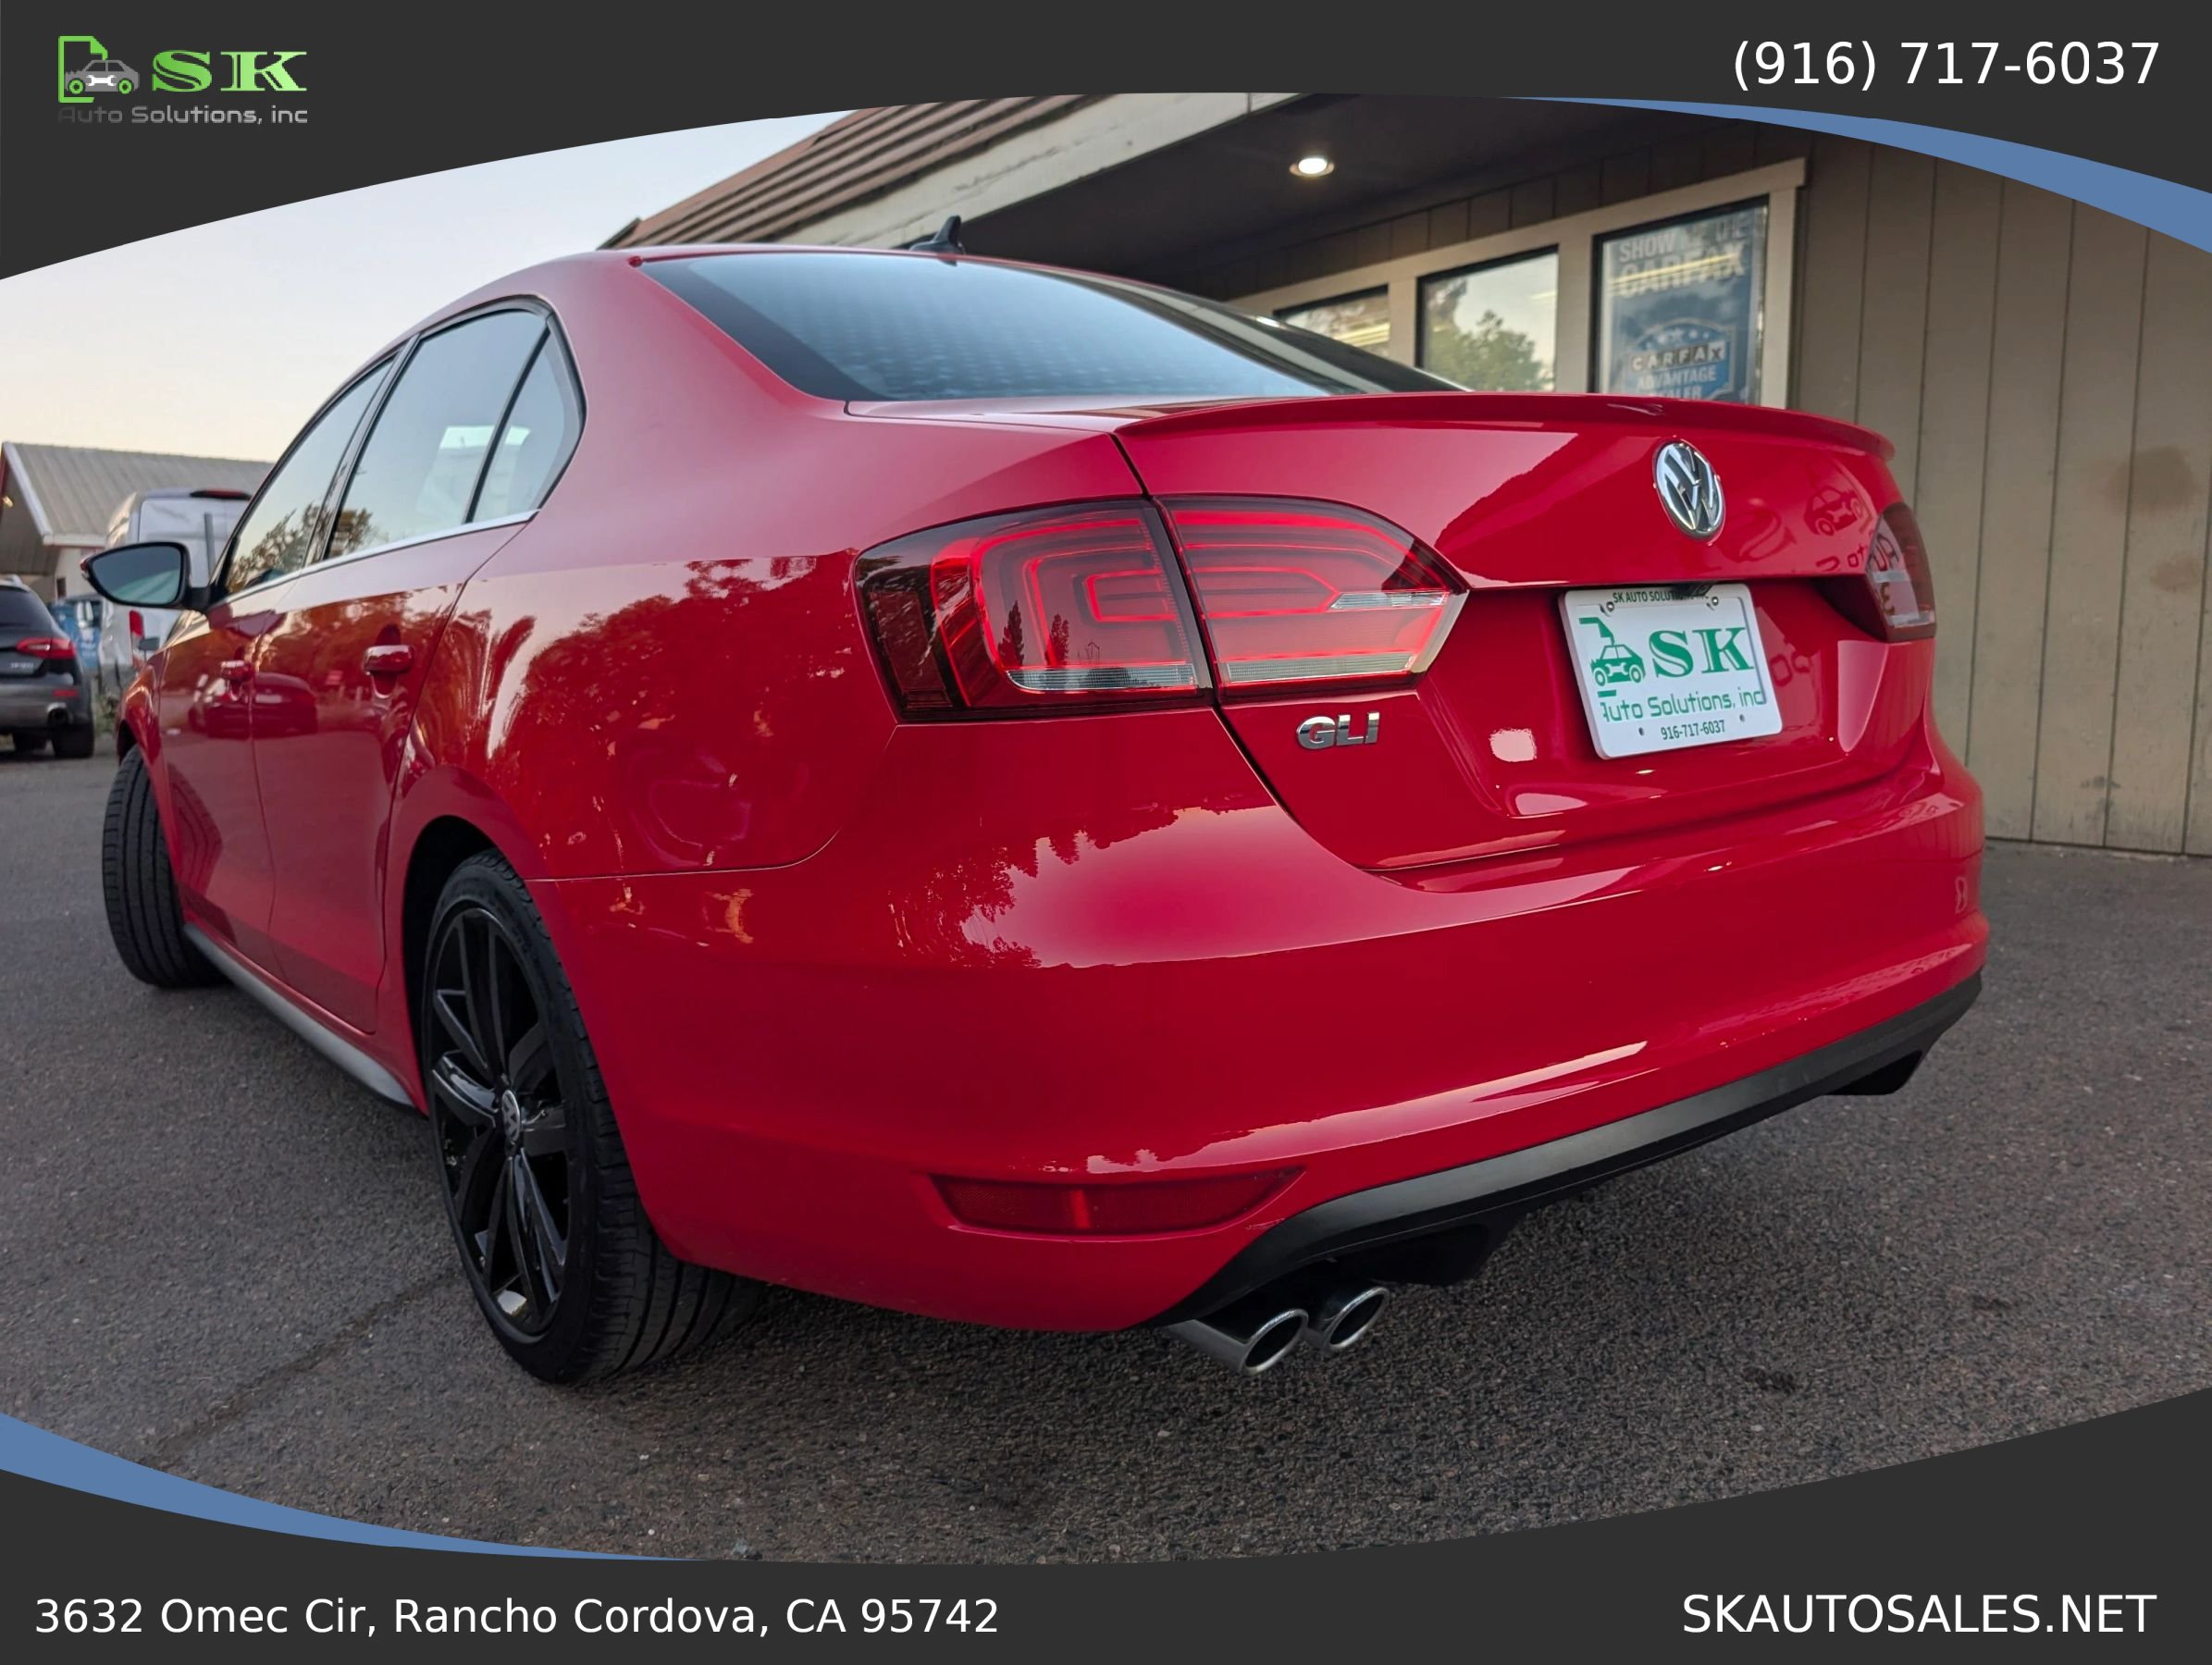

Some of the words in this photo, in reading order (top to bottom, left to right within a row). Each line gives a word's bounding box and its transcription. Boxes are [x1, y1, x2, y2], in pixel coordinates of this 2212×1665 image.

[1619, 232, 1674, 263] SHOW
[1631, 344, 1724, 371] CARFAX
[1613, 592, 1625, 604] SK
[1625, 591, 1648, 603] AUTO
[1649, 626, 1754, 678] SK
[1647, 690, 1736, 718] Solutions,
[1297, 711, 1379, 750] GLI
[1661, 719, 1725, 740] 916-717-6037
